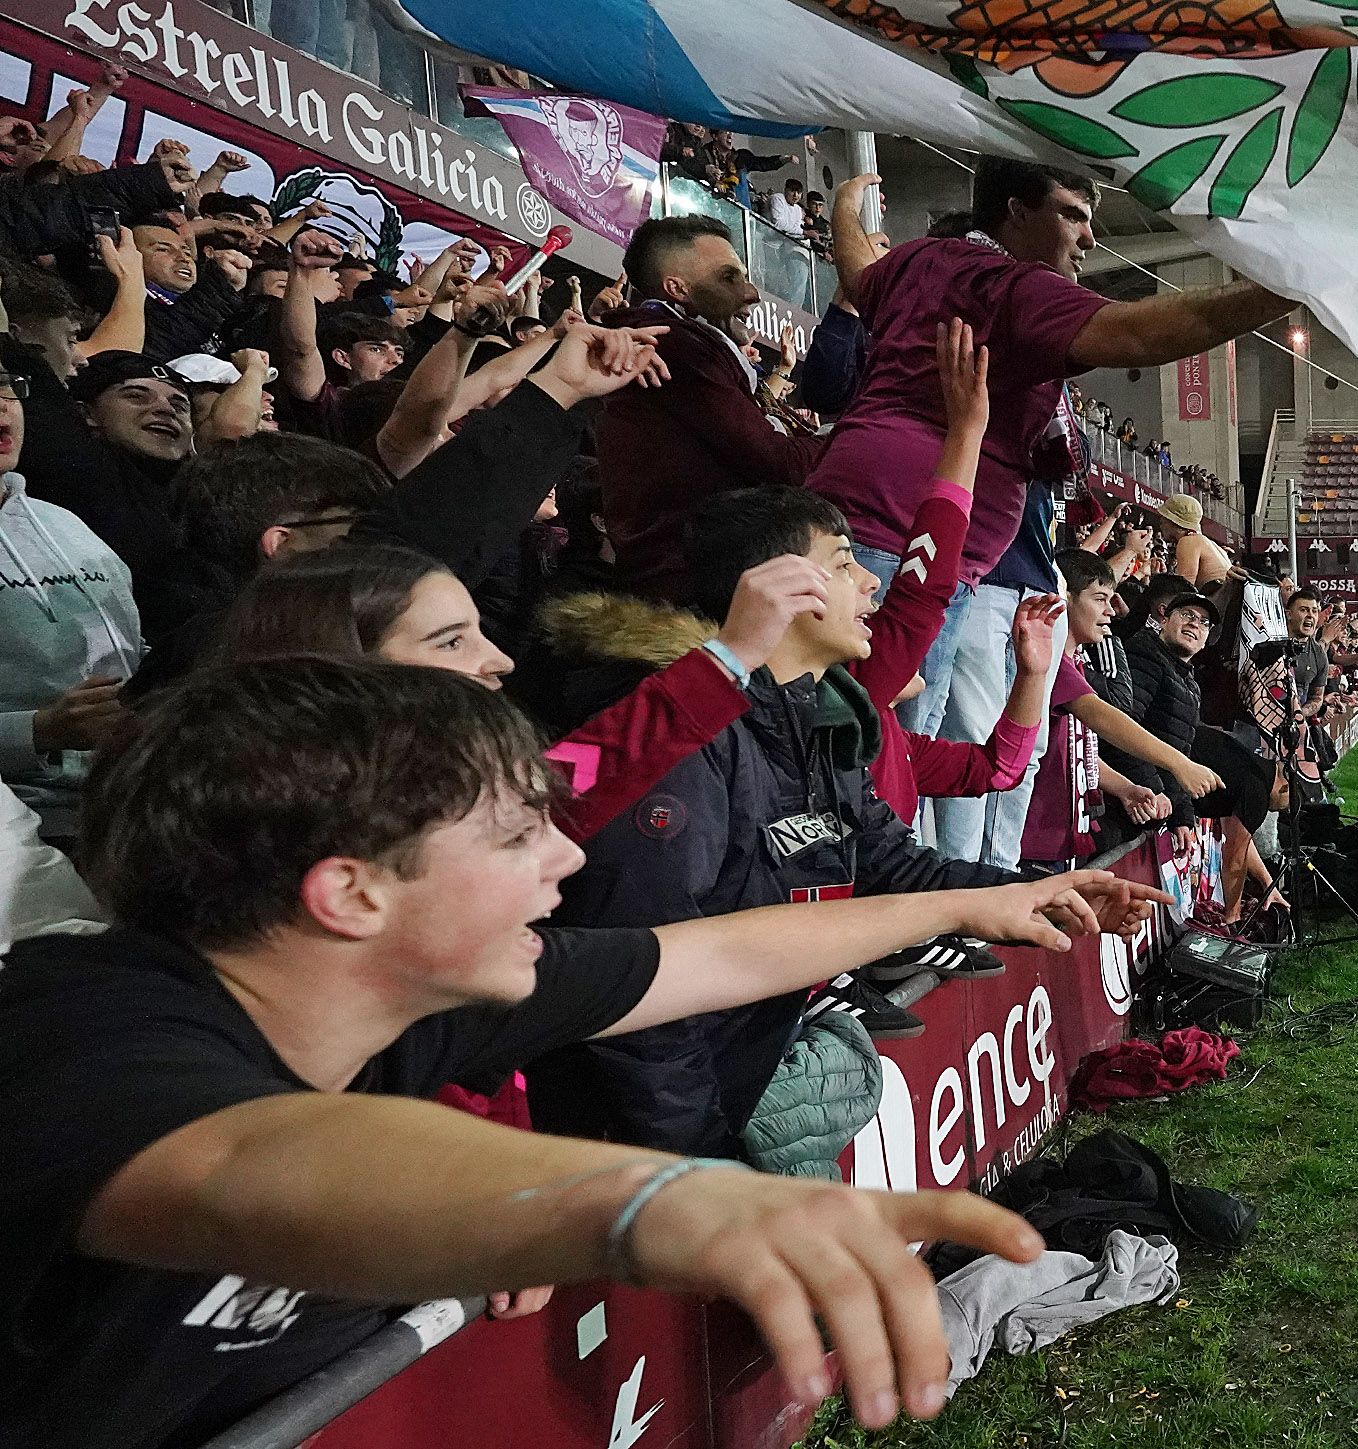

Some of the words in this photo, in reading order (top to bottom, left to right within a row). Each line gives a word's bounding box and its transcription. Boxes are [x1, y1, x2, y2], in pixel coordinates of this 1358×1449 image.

[64, 0, 335, 144] Estrella
[342, 91, 509, 221] Galicia
[929, 985, 1056, 1186] ence
[1003, 1151, 1012, 1177] &
